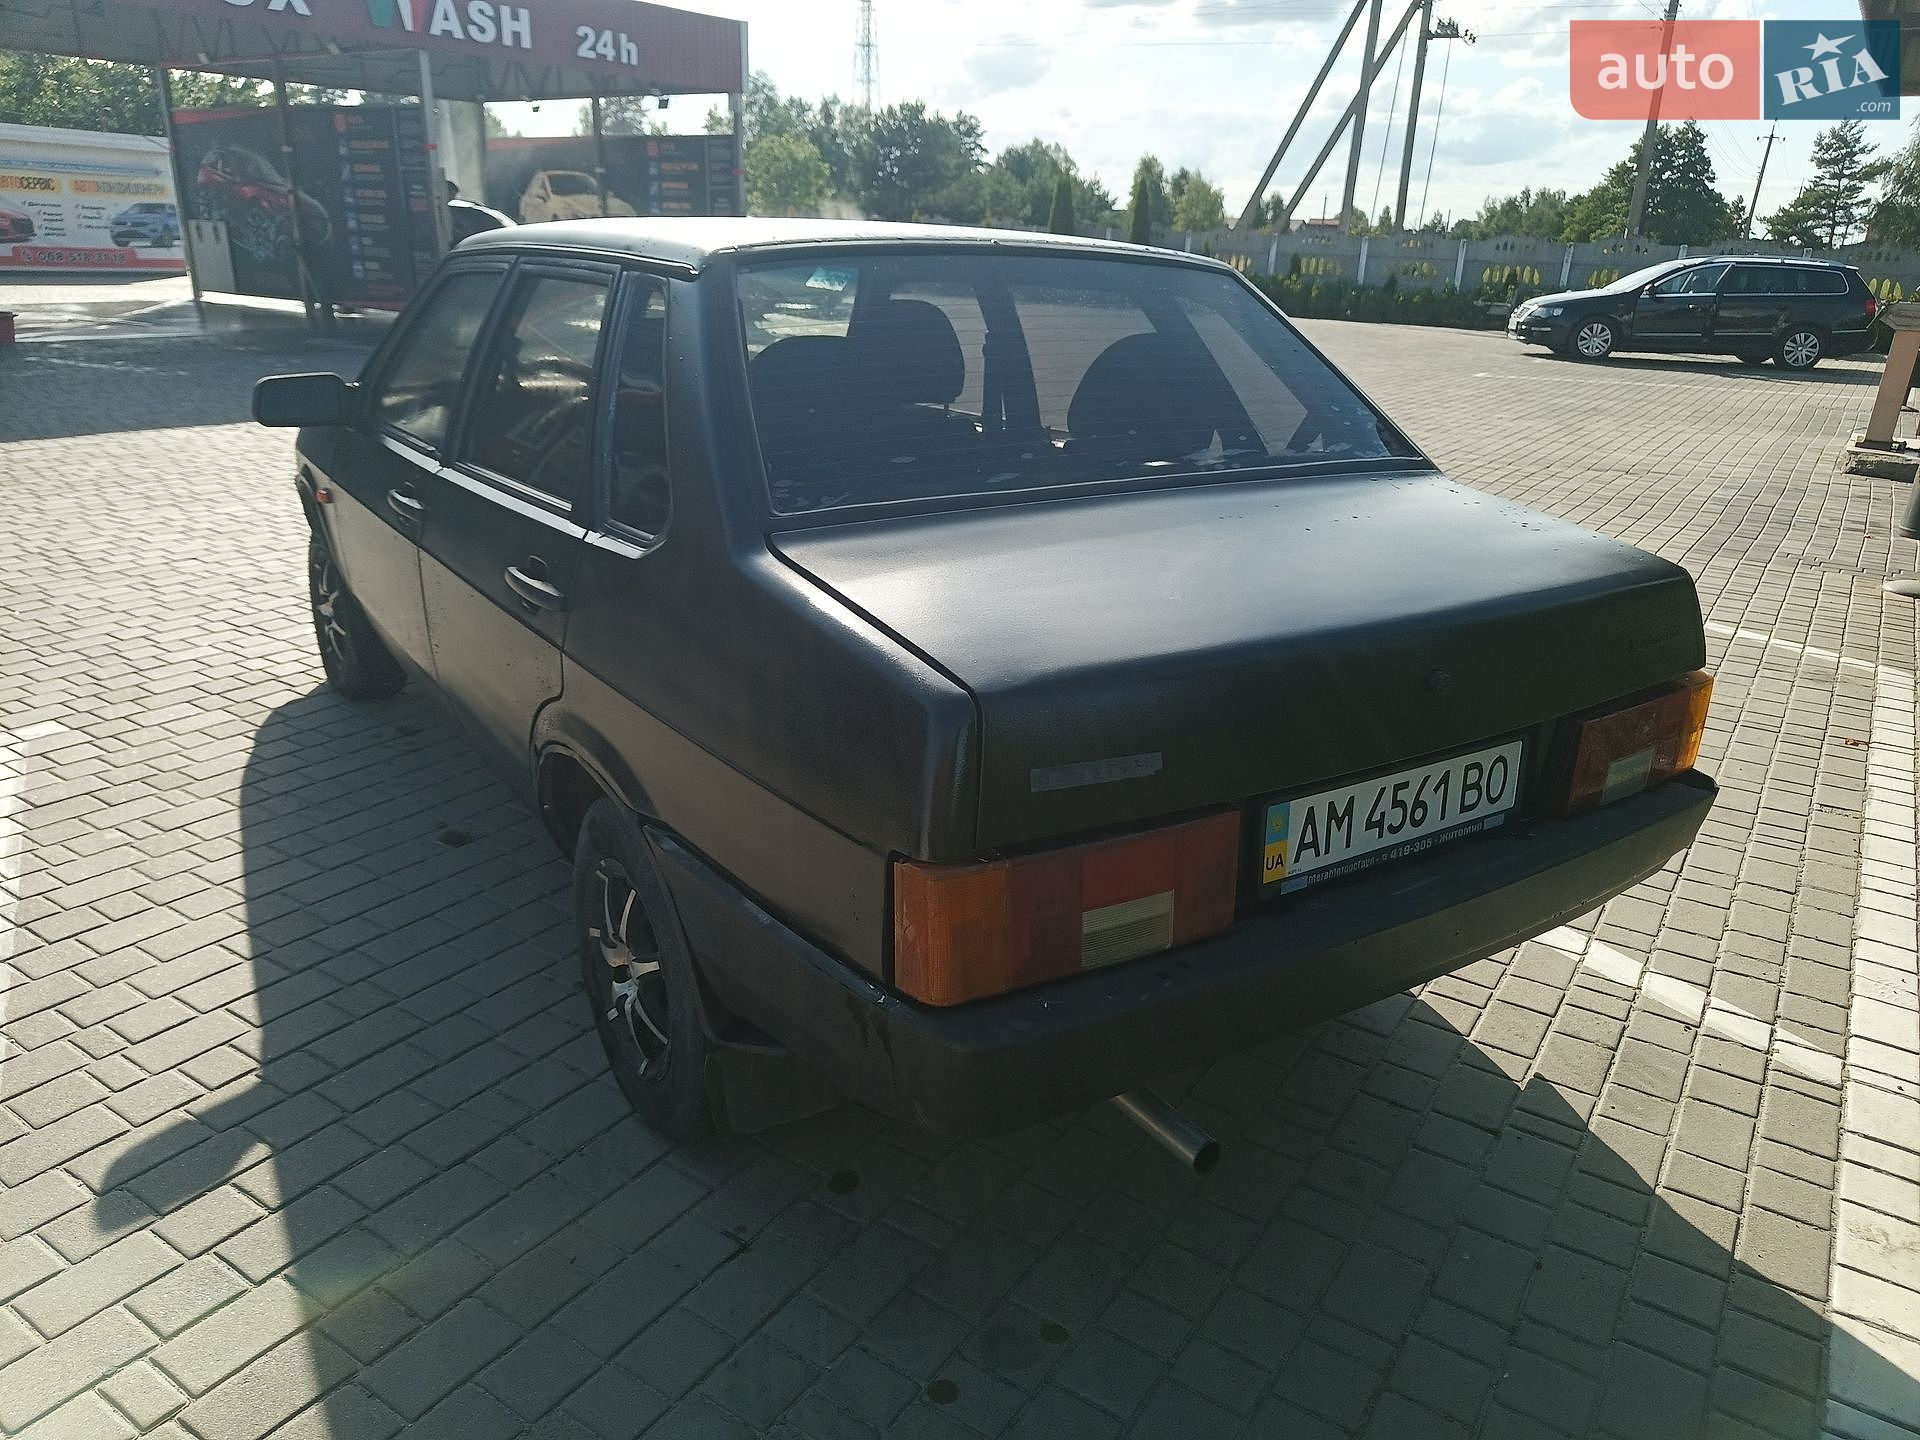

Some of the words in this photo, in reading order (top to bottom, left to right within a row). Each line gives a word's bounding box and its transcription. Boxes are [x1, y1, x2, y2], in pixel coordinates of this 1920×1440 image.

[576, 26, 639, 66] 24h
[1293, 796, 1355, 864] AM
[1364, 770, 1450, 839] 4561
[1266, 853, 1284, 871] UA
